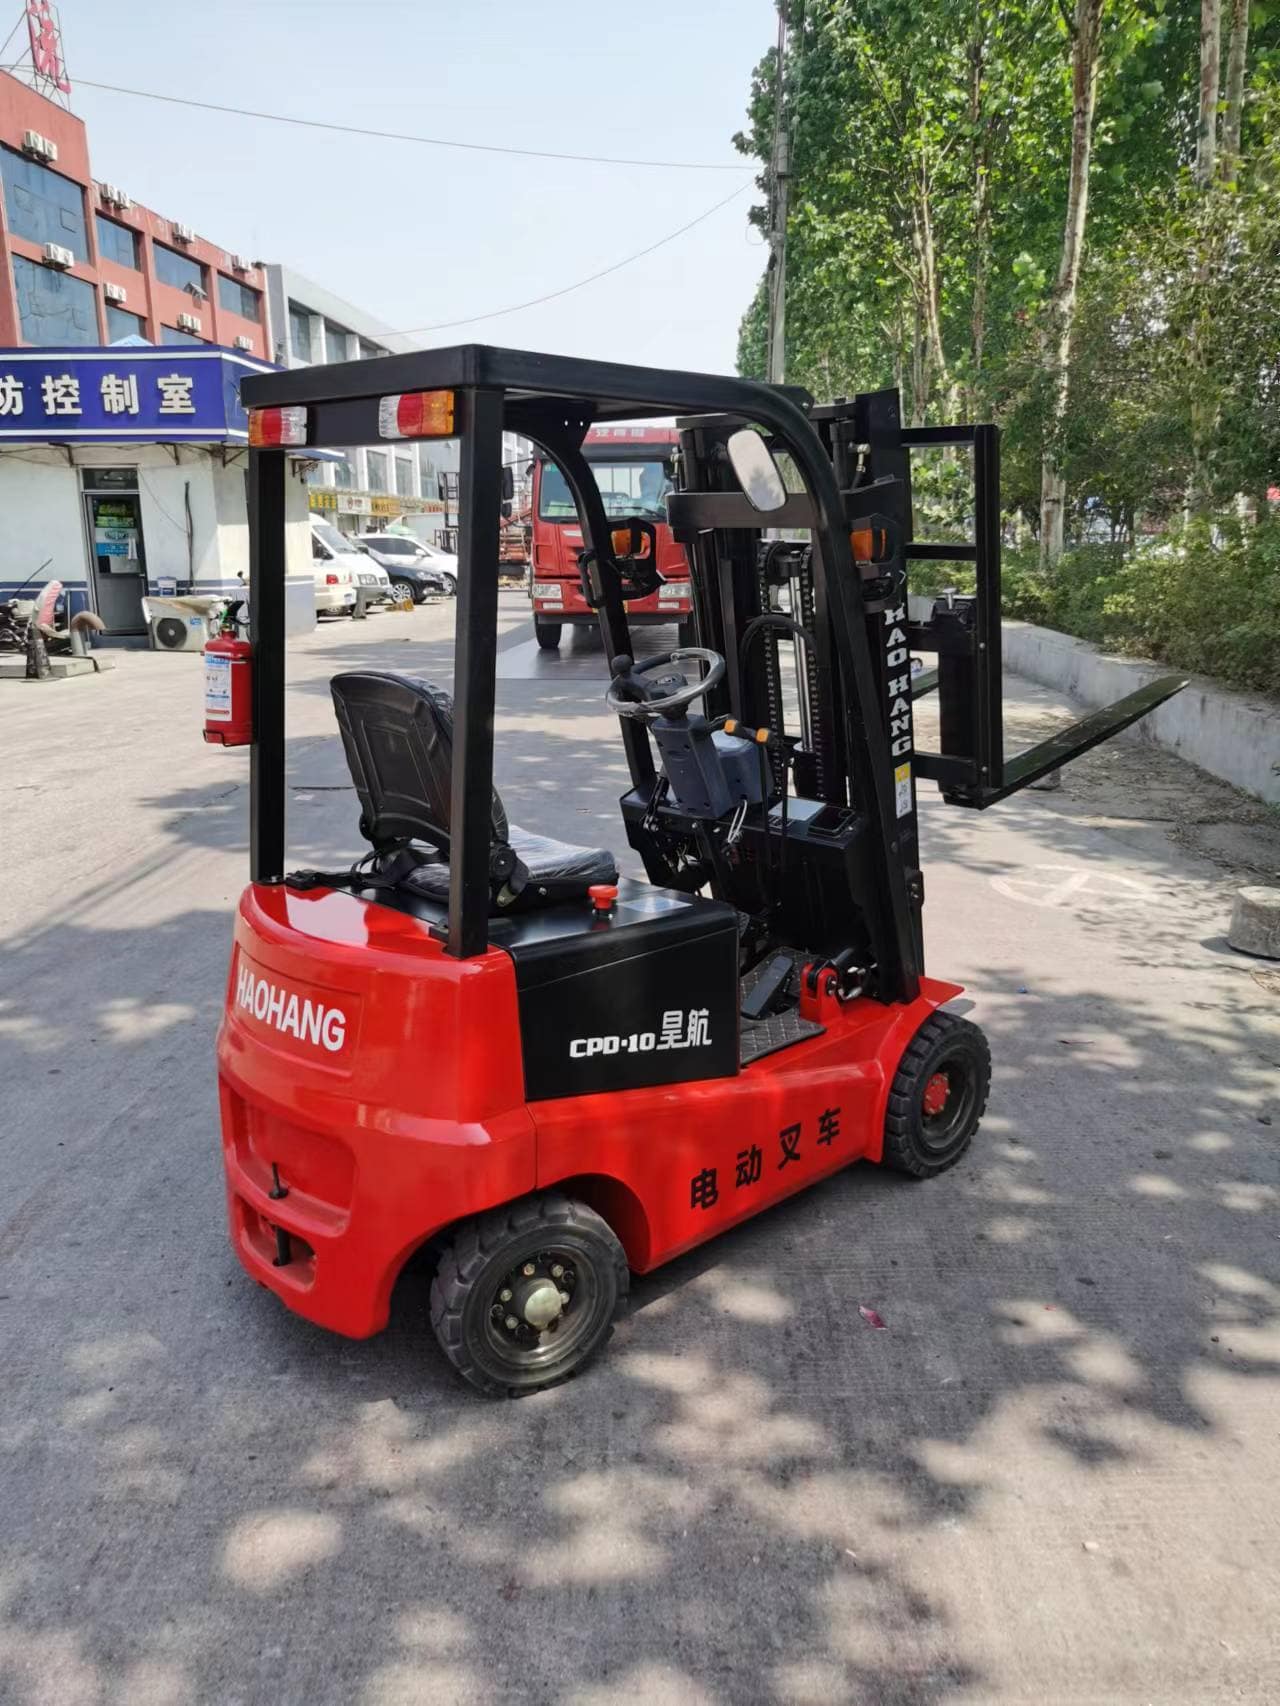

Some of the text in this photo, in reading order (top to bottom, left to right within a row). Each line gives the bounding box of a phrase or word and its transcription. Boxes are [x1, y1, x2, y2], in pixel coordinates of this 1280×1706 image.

[236, 964, 346, 1051] HAOHANG
[691, 1107, 841, 1210] 电动叉车
